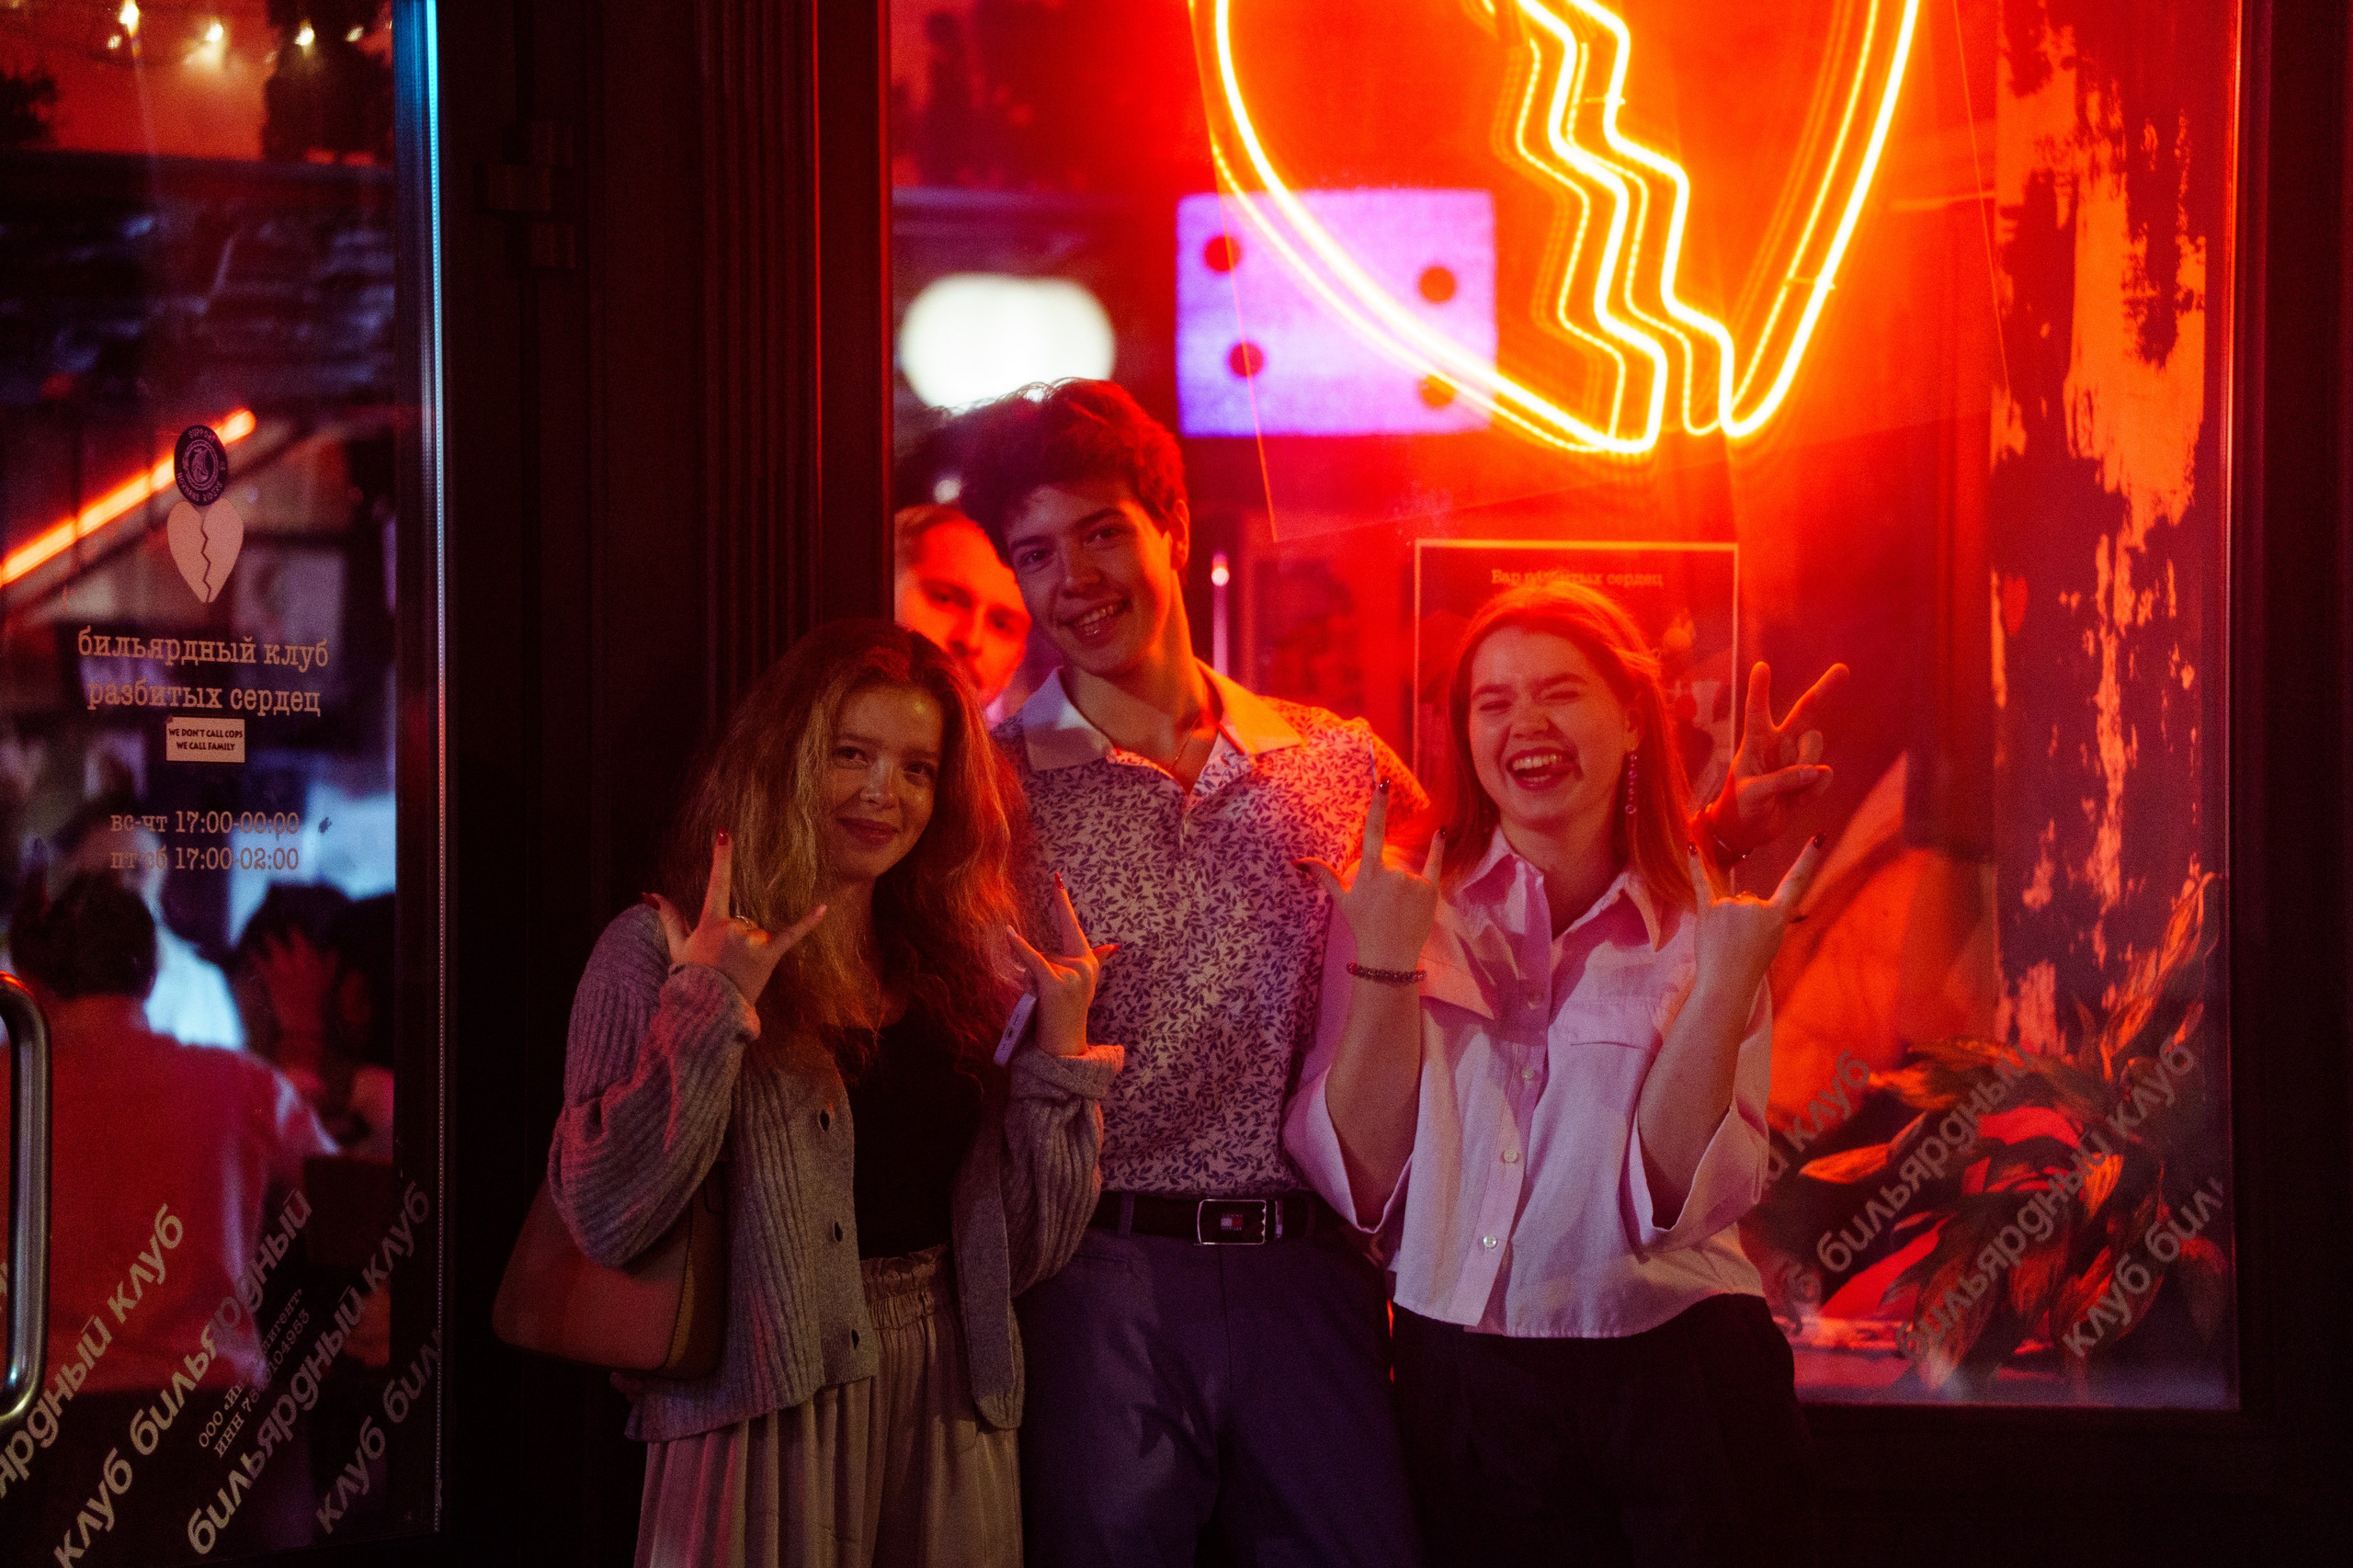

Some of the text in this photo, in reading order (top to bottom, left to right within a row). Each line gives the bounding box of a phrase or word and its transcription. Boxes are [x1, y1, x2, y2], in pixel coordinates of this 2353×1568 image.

[77, 625, 328, 673] бильярдный клуб
[86, 678, 321, 717] разбитых сердец
[168, 728, 243, 739] WE DON'T CALL COPS
[176, 742, 235, 751] WE CALL FAMILY
[110, 811, 299, 834] вс-чт 17:00-00:00
[176, 846, 299, 869] 17:00-02:00
[1784, 1050, 1870, 1152] клуб
[1816, 1044, 2034, 1272] бильярдный
[1895, 1039, 2195, 1362] бильярдный клуб
[107, 1203, 184, 1325] клуб
[2063, 1254, 2151, 1358] клуб
[53, 1188, 313, 1568] клуб бильярдный
[188, 1181, 429, 1555] бильярдный клуб
[214, 1412, 244, 1459] ИНН
[315, 1416, 385, 1534] клуб
